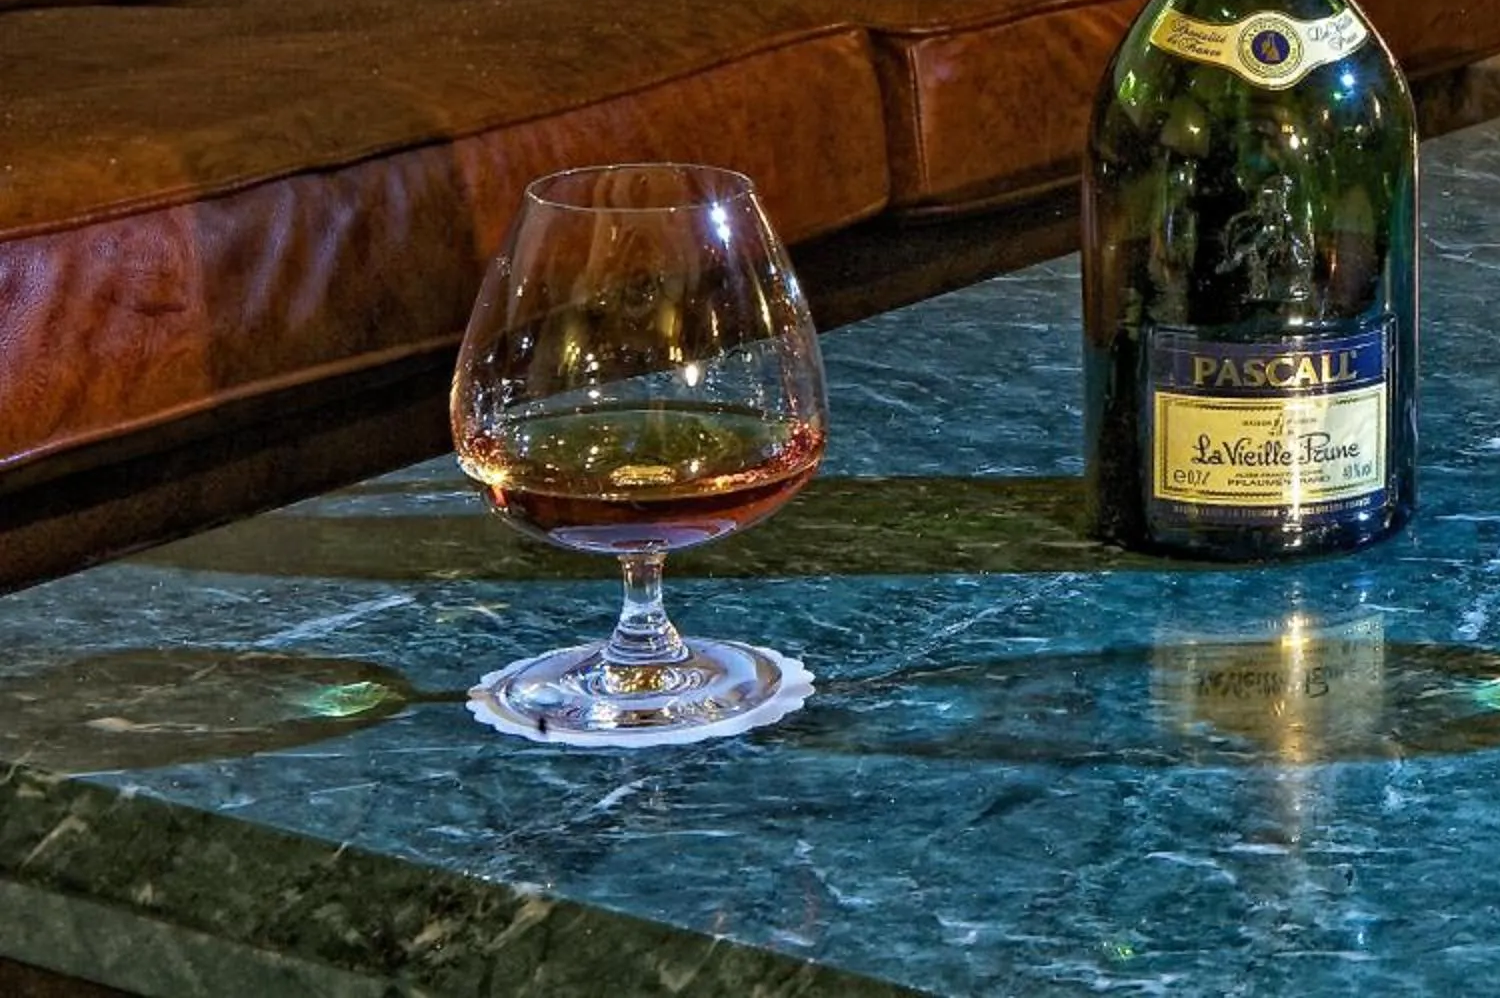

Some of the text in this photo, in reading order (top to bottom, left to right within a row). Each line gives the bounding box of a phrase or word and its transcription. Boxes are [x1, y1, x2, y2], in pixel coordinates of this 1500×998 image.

[1193, 351, 1358, 389] PASCALL
[1191, 431, 1361, 467] La Vieille Prune
